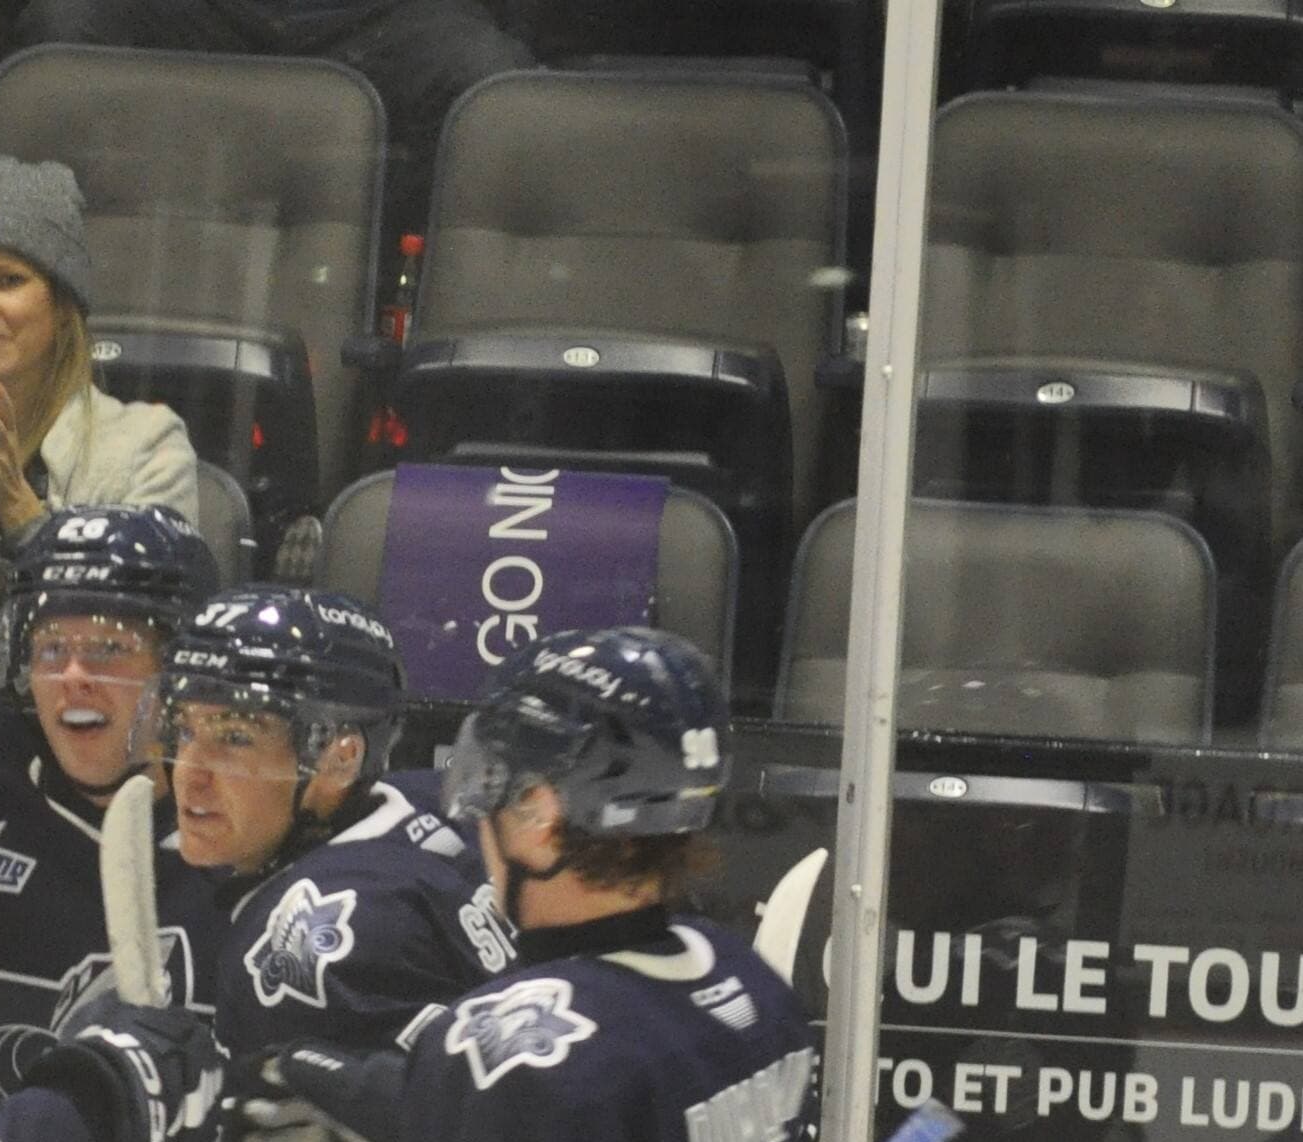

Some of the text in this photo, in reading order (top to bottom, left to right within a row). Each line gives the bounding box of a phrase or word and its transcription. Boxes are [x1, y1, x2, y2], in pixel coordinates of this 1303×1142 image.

[476, 556, 544, 666] GO
[174, 650, 229, 669] CCM
[823, 929, 1303, 1027] UI LE TOU
[952, 1062, 1023, 1115] ET
[1037, 1066, 1159, 1124] PUB
